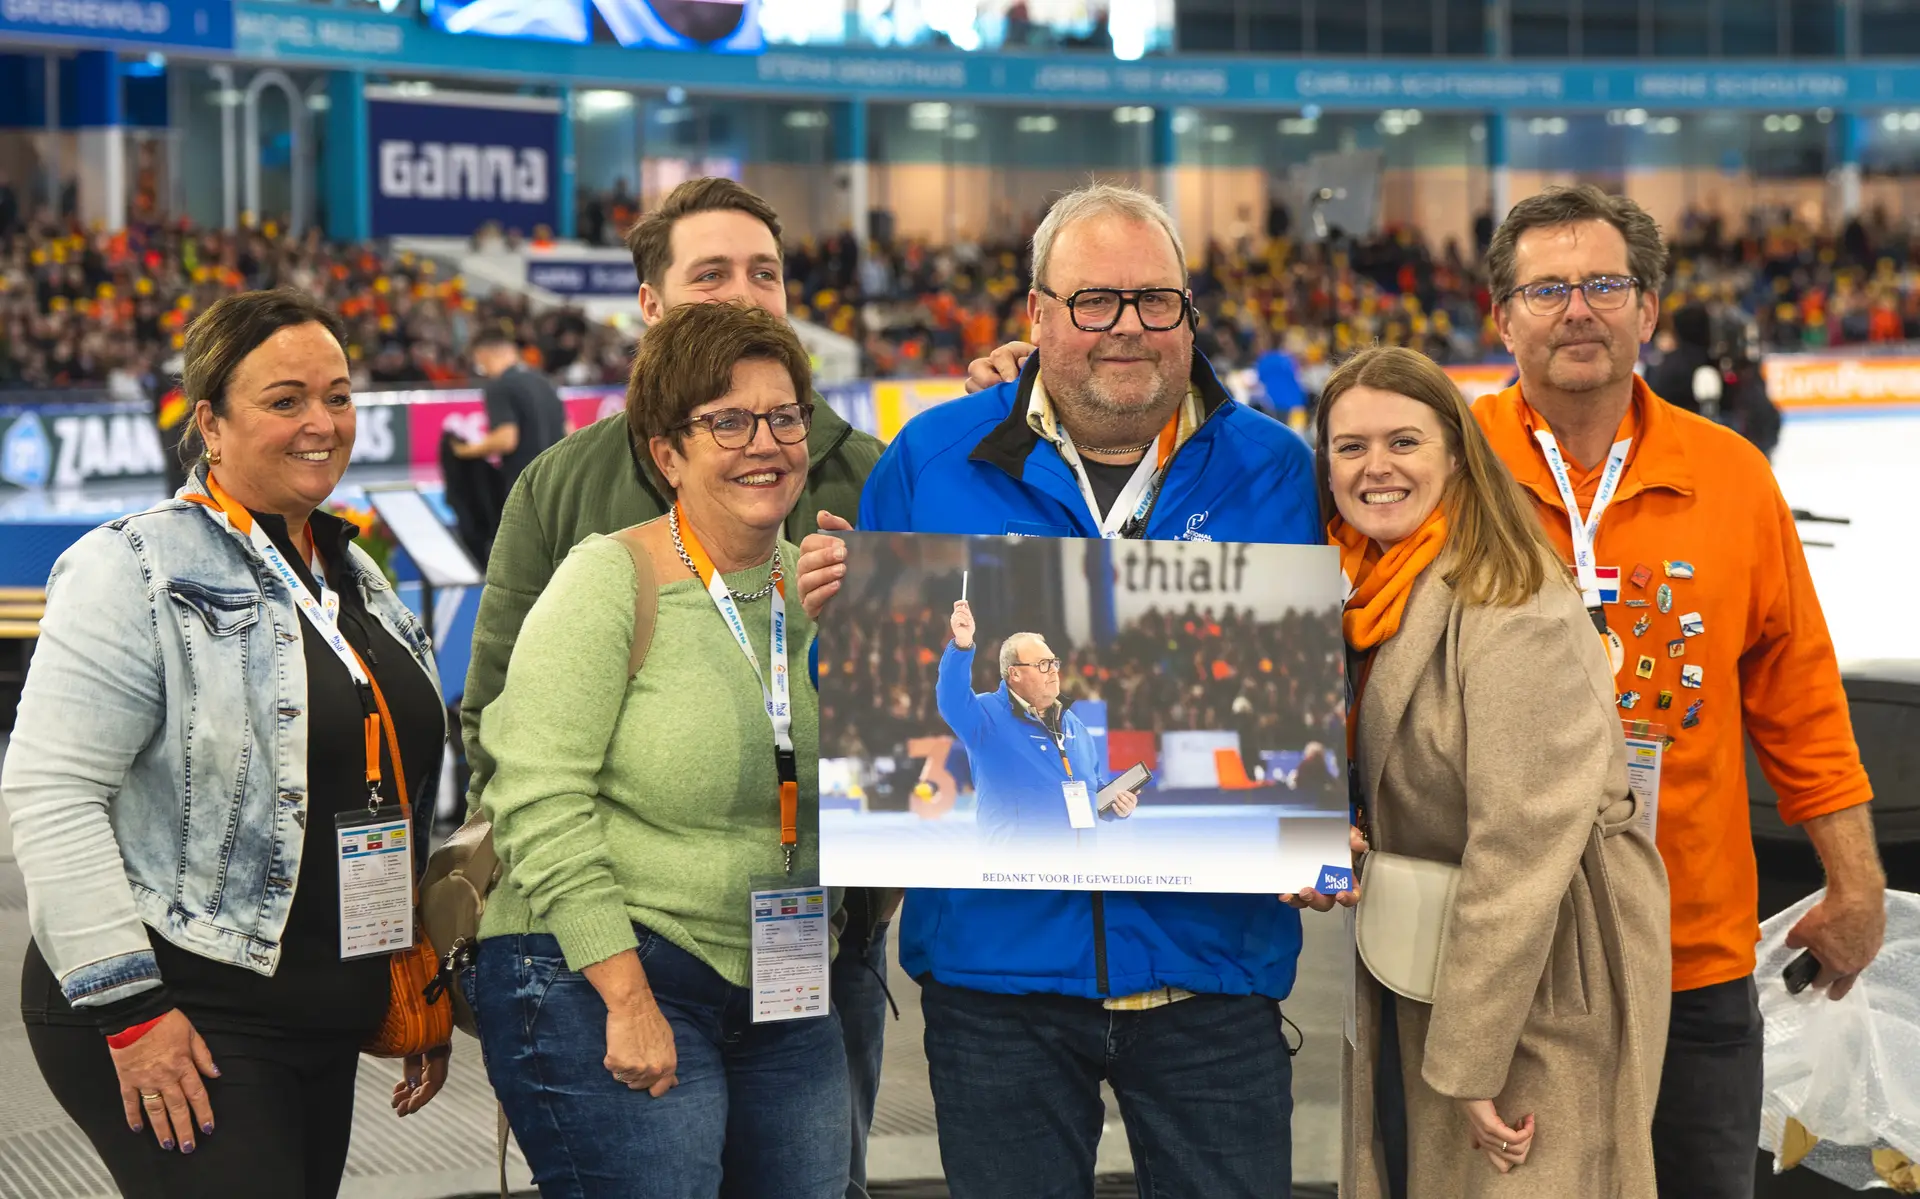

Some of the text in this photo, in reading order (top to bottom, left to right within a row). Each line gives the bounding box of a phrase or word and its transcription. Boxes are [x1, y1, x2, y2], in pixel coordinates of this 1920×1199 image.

[1551, 458, 1569, 494] DAIKIN
[1599, 464, 1617, 501] DAIKIN
[269, 554, 299, 590] DAIKIN
[1126, 542, 1252, 592] thialf
[725, 606, 747, 645] DAIKIN
[775, 619, 784, 655] DAIKIN
[982, 873, 1193, 885] BEDANKT VOOR JE GEWELDIGE INZET!
